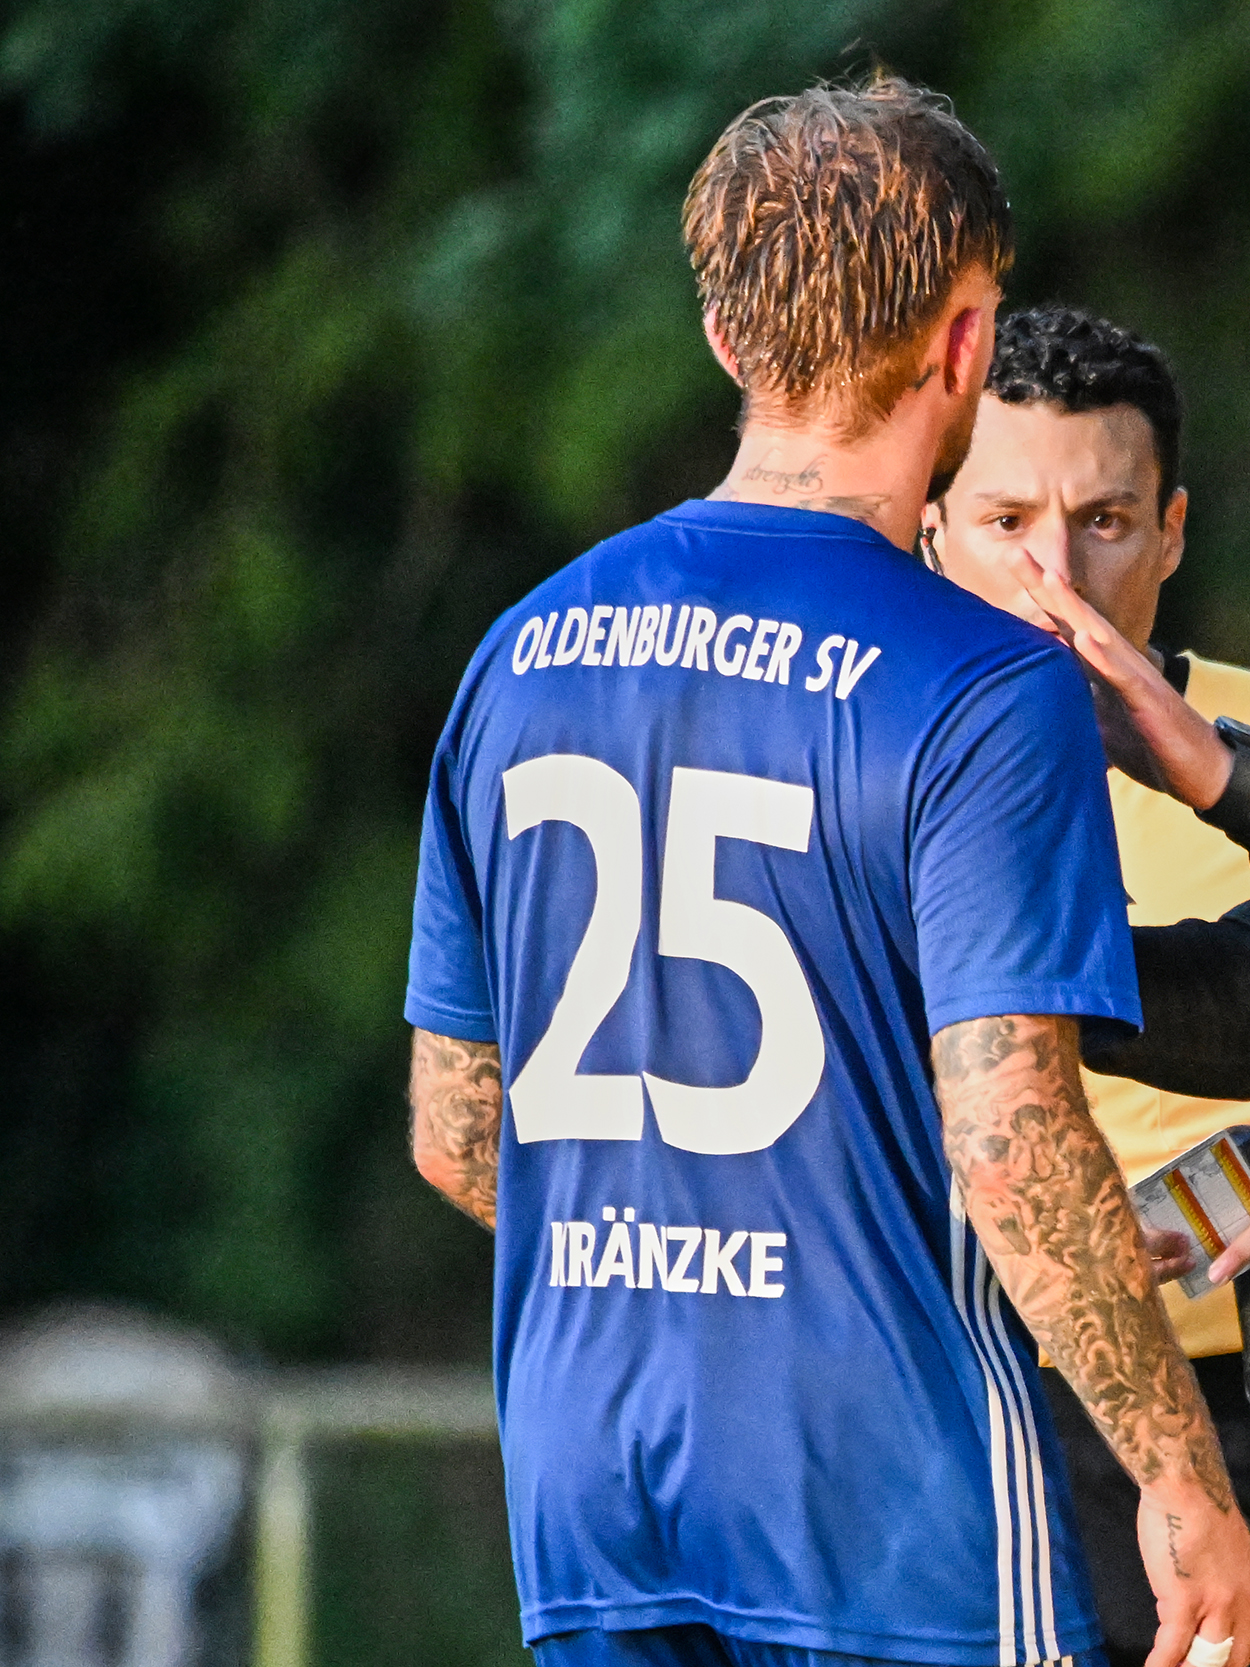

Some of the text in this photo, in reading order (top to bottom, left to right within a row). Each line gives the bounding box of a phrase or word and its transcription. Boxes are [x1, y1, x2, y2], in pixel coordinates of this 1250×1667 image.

[512, 604, 882, 700] OLDENBURGER SV
[502, 753, 825, 1156] 25
